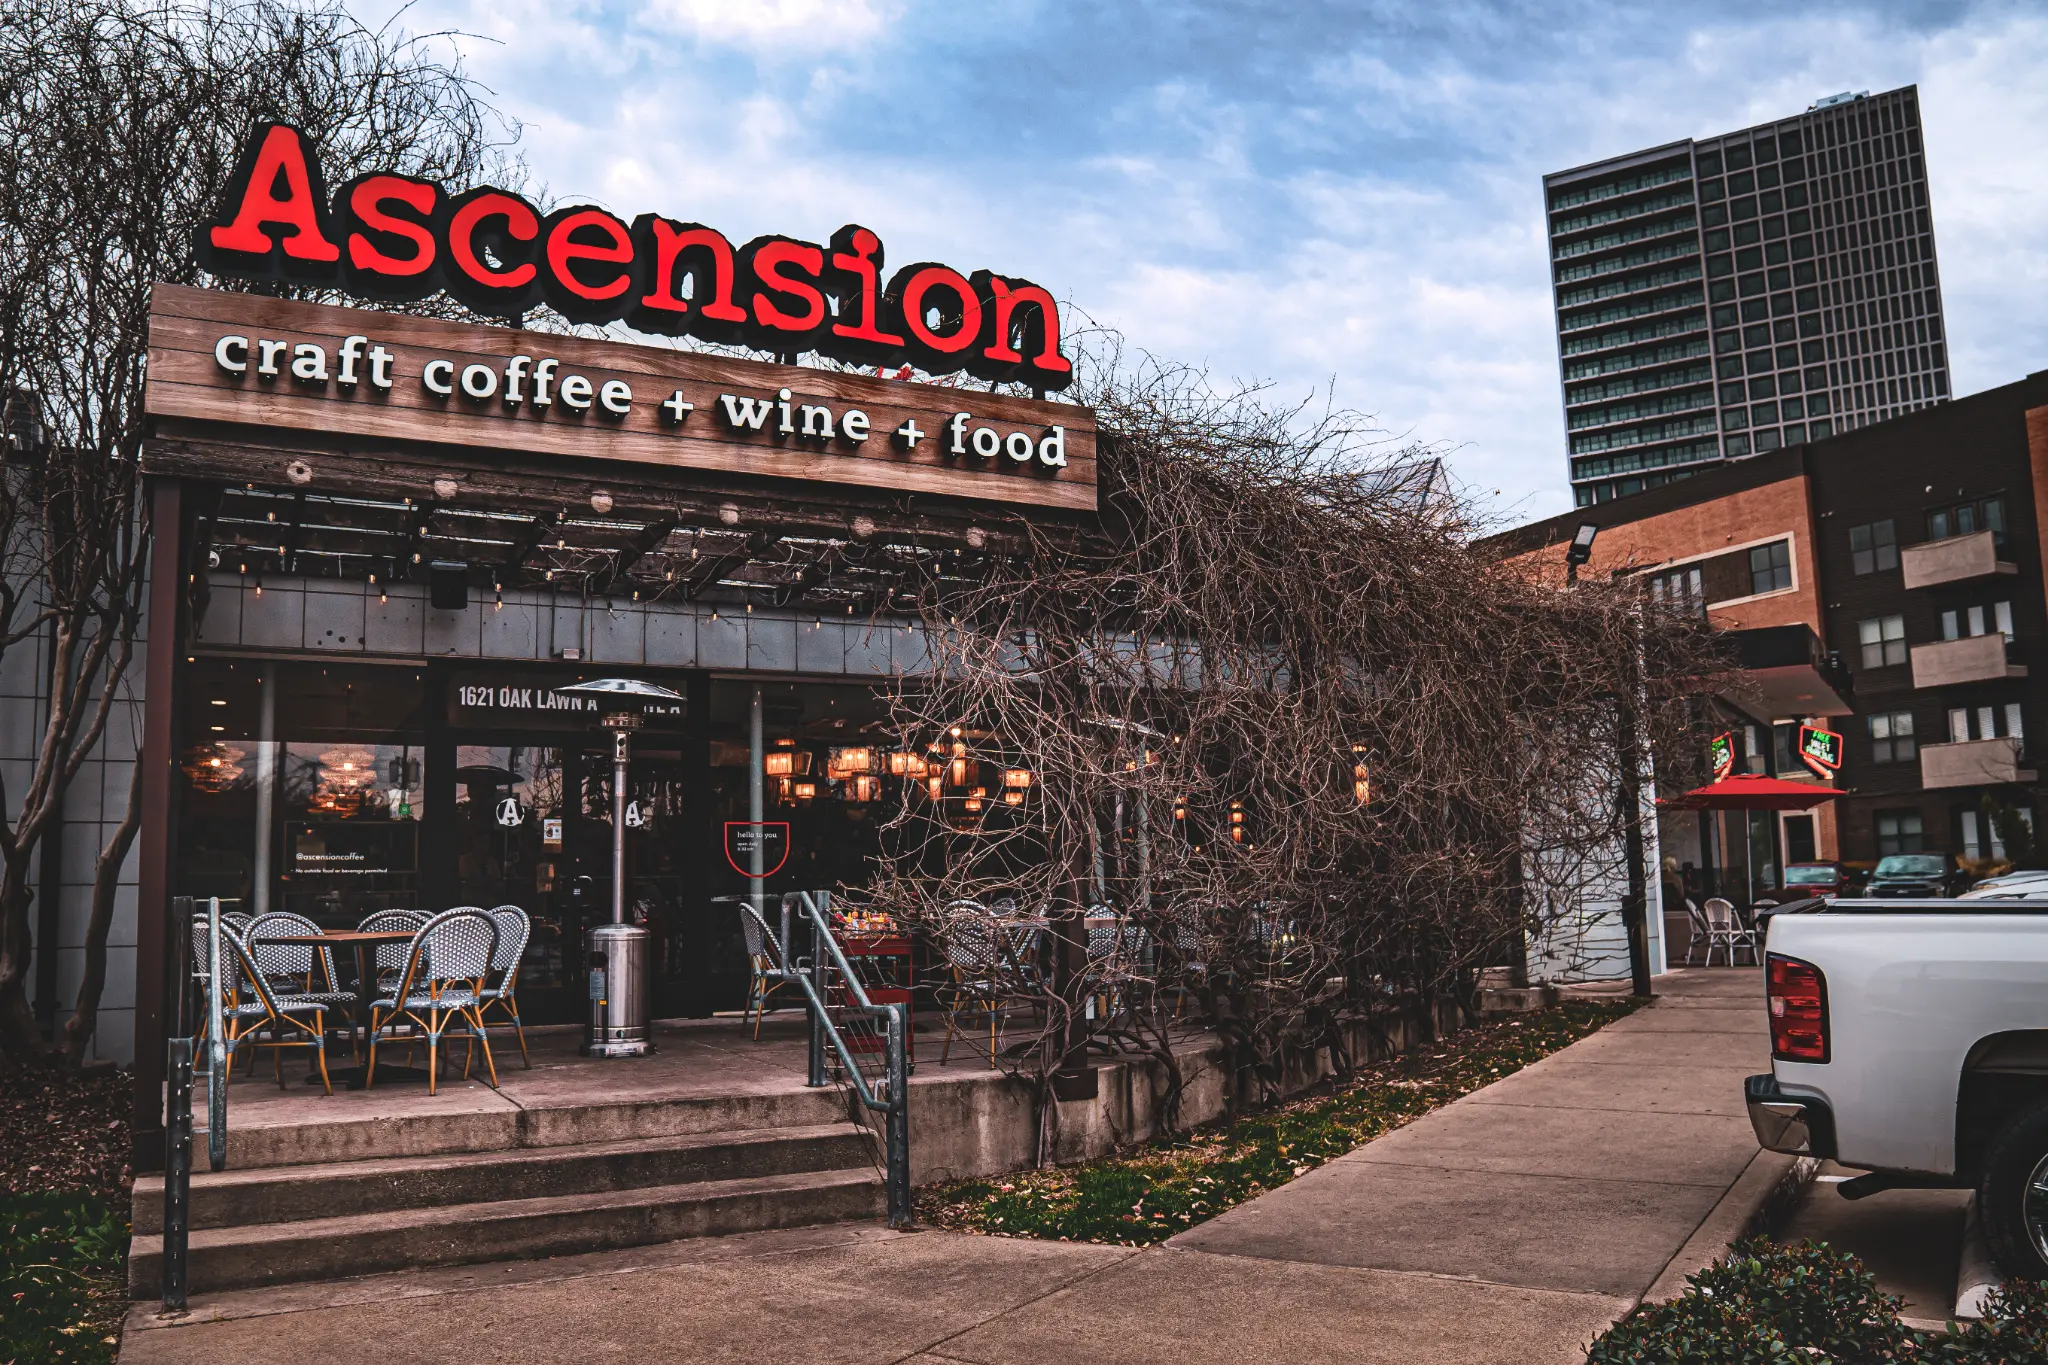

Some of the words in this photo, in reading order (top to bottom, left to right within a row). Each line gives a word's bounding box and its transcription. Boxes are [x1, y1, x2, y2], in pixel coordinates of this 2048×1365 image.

[211, 125, 1071, 371] Ascension
[215, 335, 394, 387] craft
[423, 355, 633, 412] coffee
[664, 391, 694, 421] +
[720, 388, 871, 441] wine
[898, 419, 925, 448] +
[950, 412, 1068, 468] food
[459, 686, 494, 706] 1621
[500, 688, 531, 708] OAK
[537, 689, 582, 711] LAWN
[296, 852, 365, 861] @ascensioncoffee
